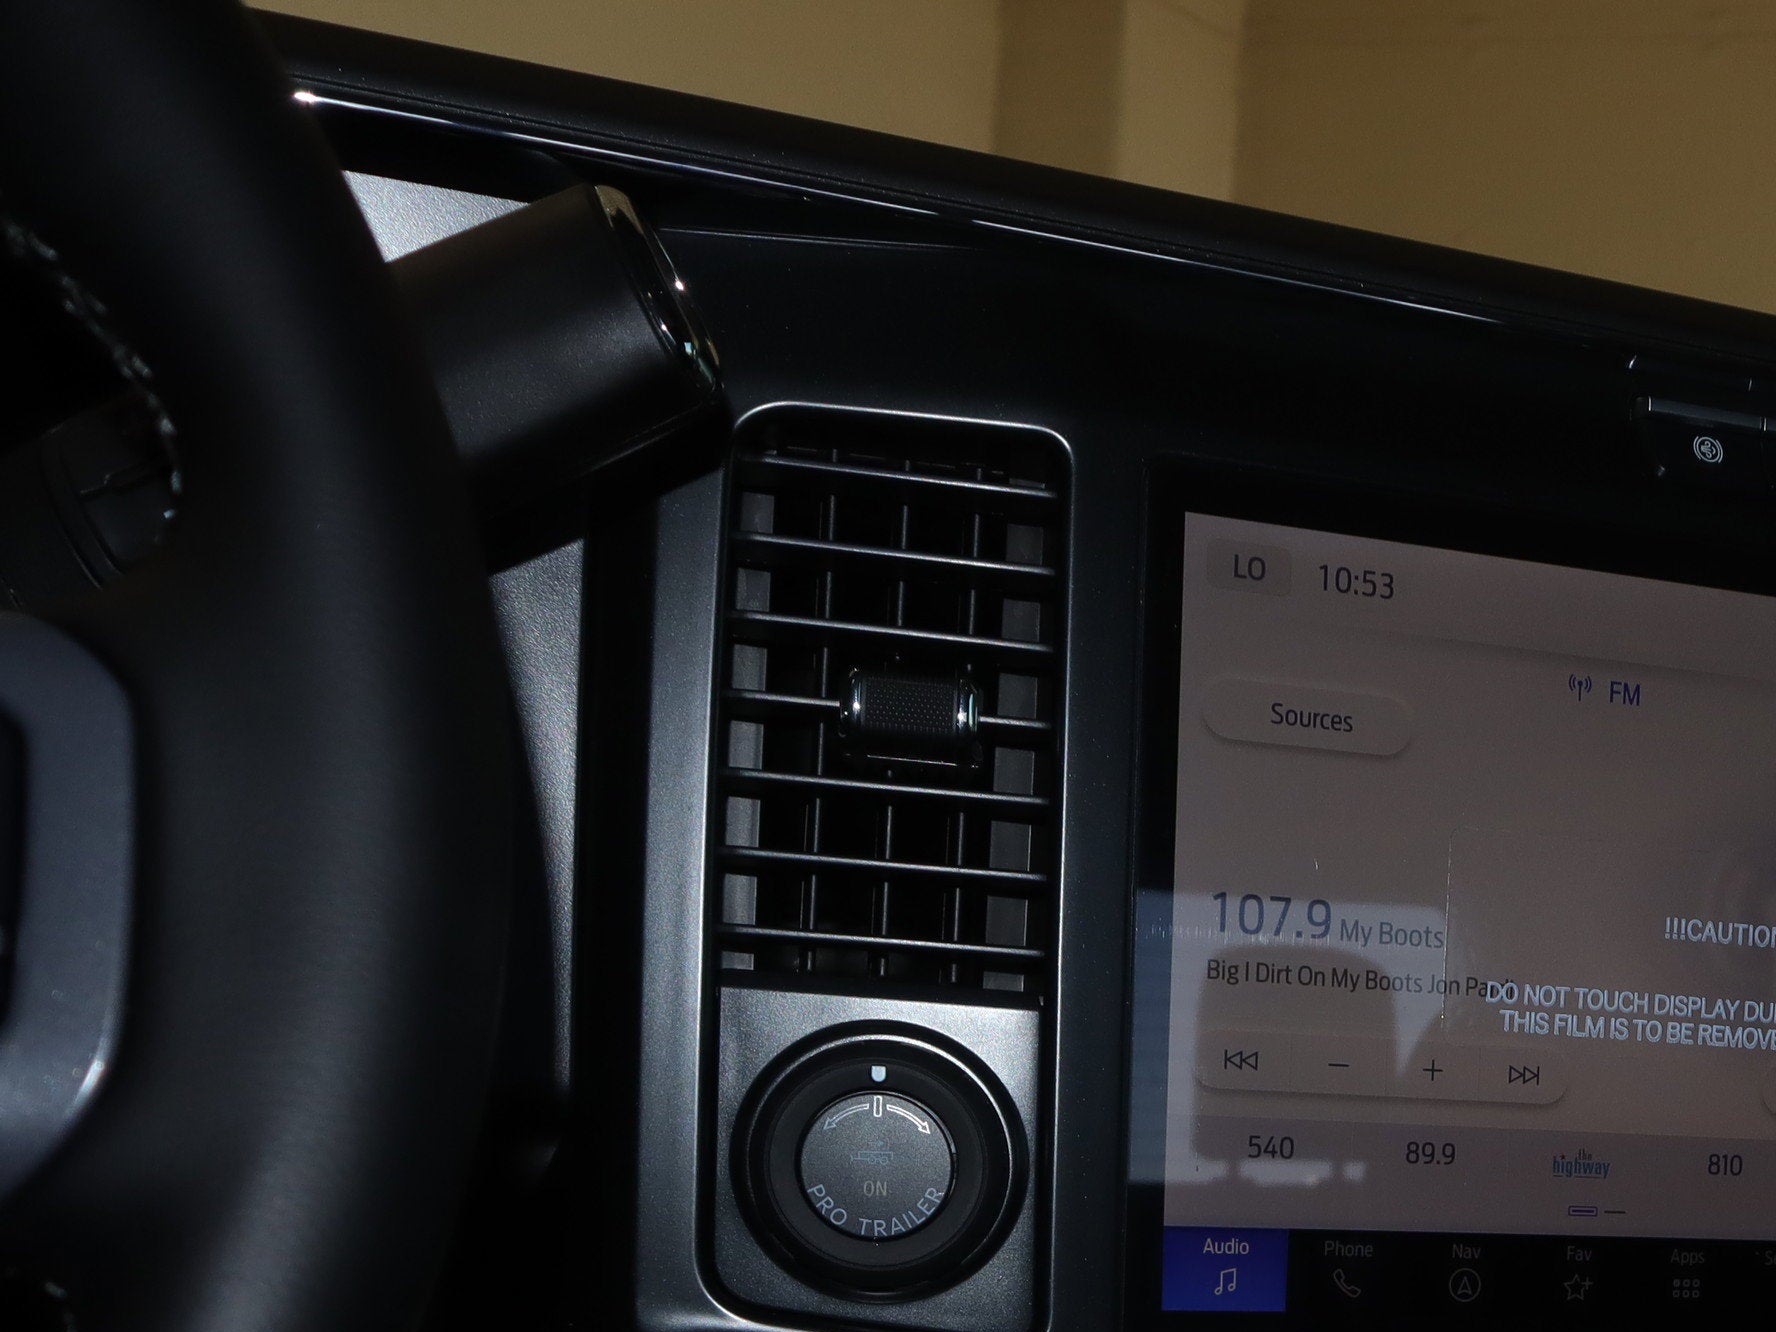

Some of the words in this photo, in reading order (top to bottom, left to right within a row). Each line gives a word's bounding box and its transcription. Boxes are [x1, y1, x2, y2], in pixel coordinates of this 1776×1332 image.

[1232, 554, 1266, 581] LO
[1318, 564, 1396, 600] 10:53
[1609, 681, 1641, 706] FM
[1270, 702, 1354, 733] Sources
[1211, 890, 1332, 940] 107.9
[1339, 919, 1373, 947] My
[1378, 923, 1444, 949] Boots
[1206, 959, 1240, 987] Big
[1255, 962, 1293, 986] Dirt
[1298, 965, 1326, 988] On
[1330, 967, 1360, 995] My
[1364, 969, 1423, 995] Boots
[1427, 973, 1461, 996] Jon
[1485, 980, 1520, 1005] DO
[1523, 983, 1570, 1010] NOT
[1573, 986, 1649, 1015] TOUCH
[1653, 993, 1739, 1022] DISPLAY
[1499, 1008, 1549, 1035] THIS
[1553, 1012, 1606, 1040] FILM
[1609, 1017, 1629, 1041] IS
[1632, 1018, 1662, 1044] TO
[1665, 1021, 1693, 1046] BE
[1247, 1135, 1296, 1160] 540
[1405, 1141, 1456, 1167] 89.9
[1552, 1154, 1611, 1180] highway
[1707, 1152, 1744, 1177] 810
[862, 1179, 889, 1198] ON
[806, 1183, 849, 1227] PRO
[858, 1186, 944, 1237] TRAILER
[1202, 1236, 1251, 1256] Audio
[1323, 1239, 1375, 1259] Phone
[1450, 1242, 1483, 1260] Nav
[1565, 1244, 1594, 1263] Fav
[1669, 1247, 1706, 1266] Apps
